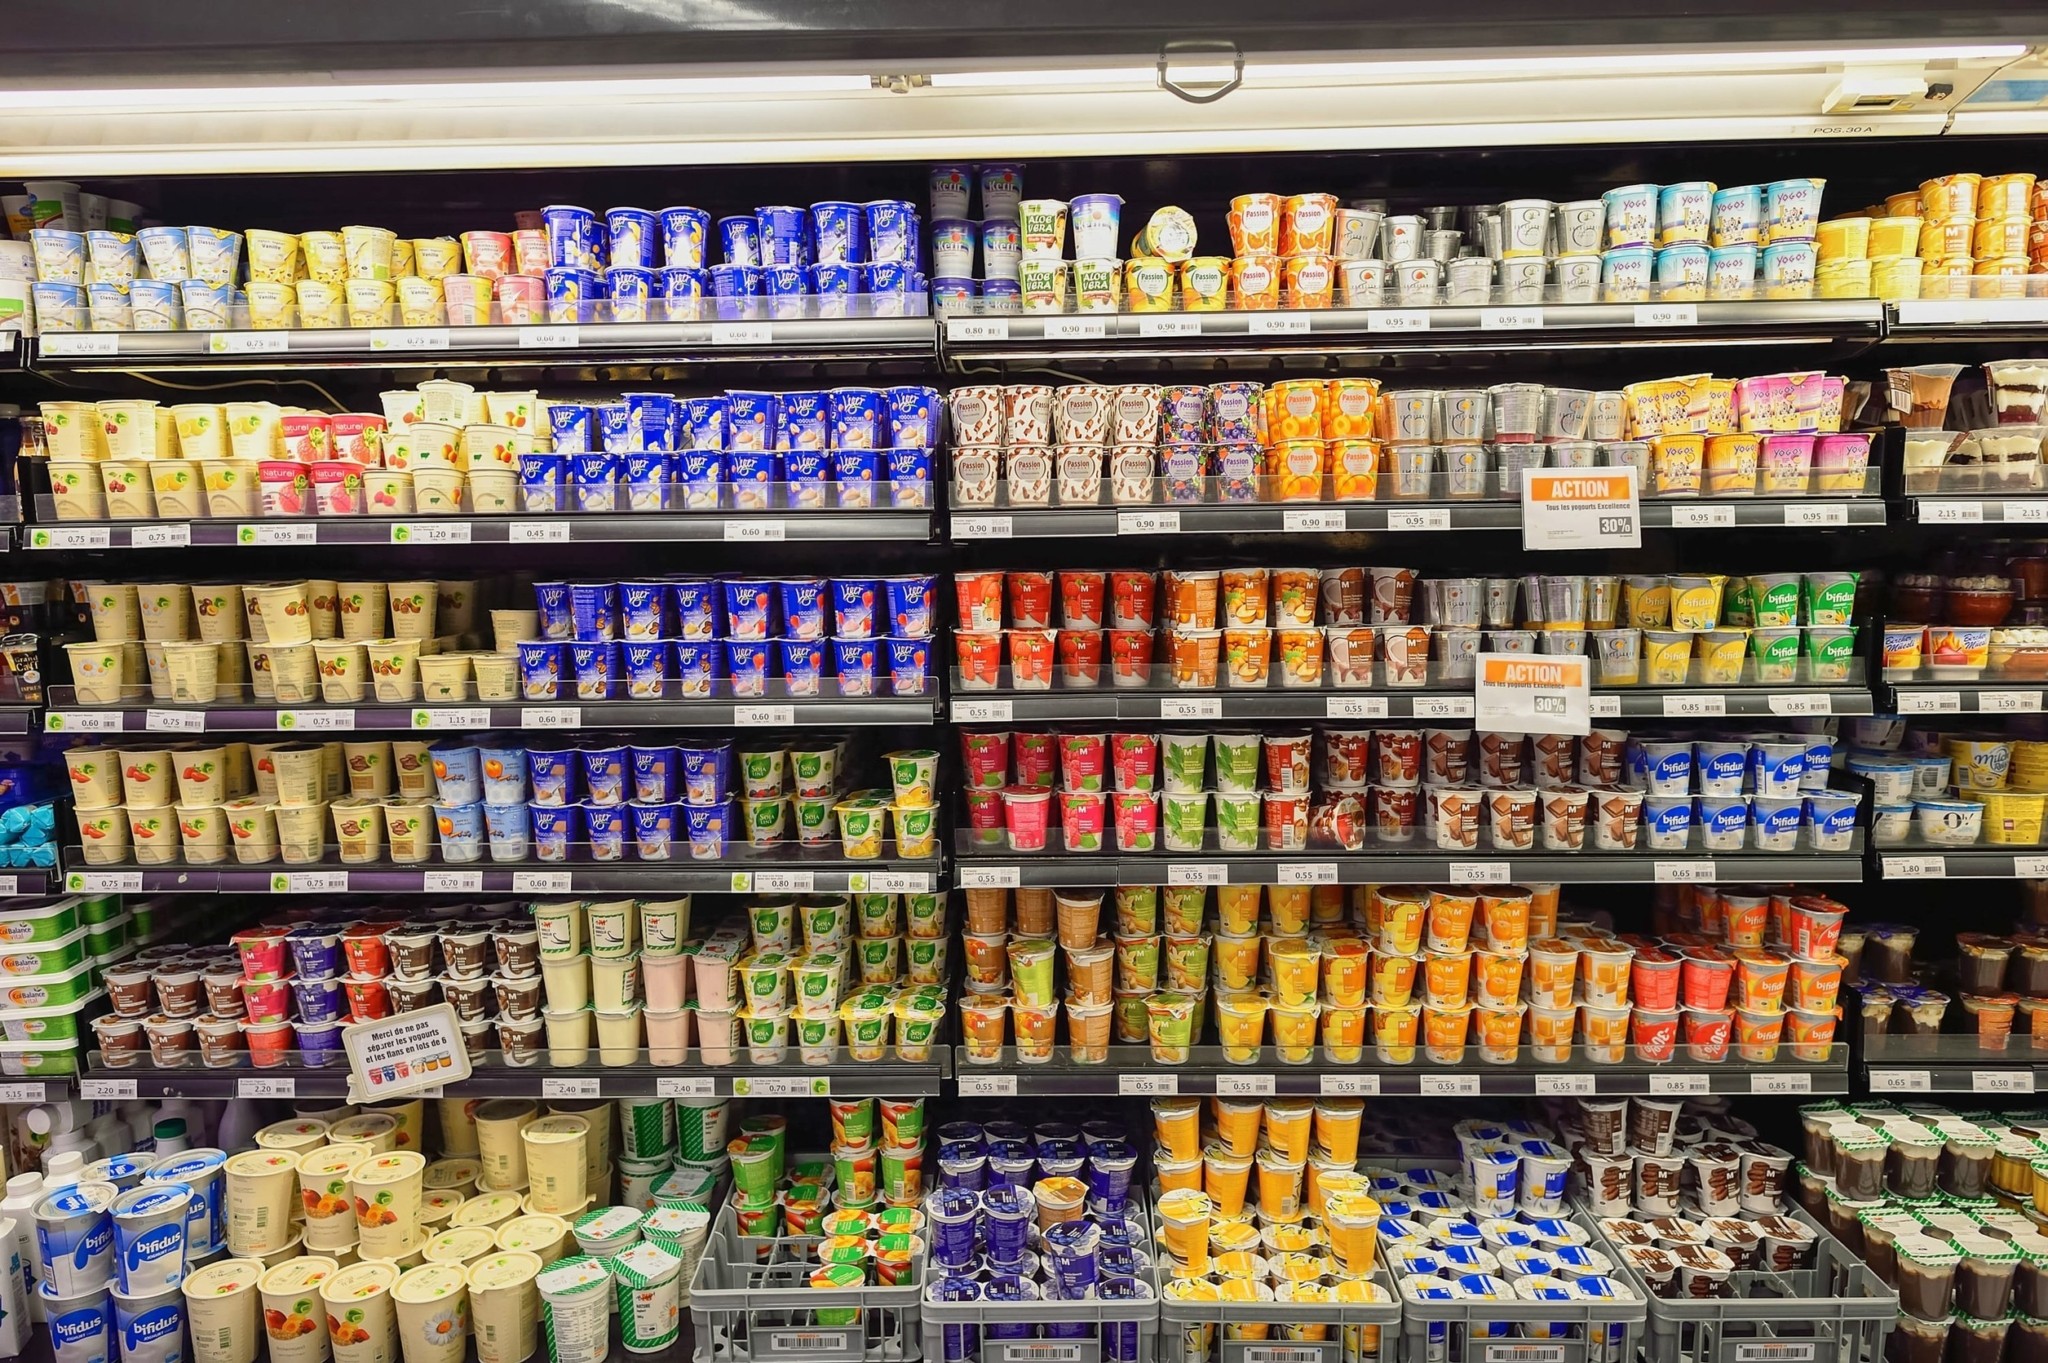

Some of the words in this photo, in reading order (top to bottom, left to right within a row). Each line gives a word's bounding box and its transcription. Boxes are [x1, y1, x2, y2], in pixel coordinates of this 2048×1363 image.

[1777, 189, 1808, 203] YOGOS
[1716, 200, 1745, 214] YOGOS
[1246, 210, 1268, 218] Passion
[1028, 215, 1052, 225] ALOE
[1028, 223, 1053, 234] VERA
[1777, 253, 1806, 267] YOGOS
[1026, 273, 1051, 282] ALOE
[1141, 273, 1164, 281] Passion
[1026, 281, 1051, 291] VERA
[965, 327, 983, 335] 0.80
[1221, 399, 1242, 407] Passion
[1289, 396, 1311, 404] Passion
[959, 402, 979, 410] Passion
[1666, 447, 1694, 456] YOGOS
[1774, 447, 1802, 457] YOGOS
[316, 470, 345, 478] Naturel
[1552, 480, 1609, 498] ACTION
[1571, 504, 1596, 512] yogourts
[1601, 518, 1631, 533] 30%
[148, 533, 165, 541] 0.75
[1506, 665, 1561, 682] ACTION
[1536, 697, 1565, 711] 30%
[1805, 754, 1831, 764] bifidus
[1663, 762, 1690, 772] bifidus
[1663, 815, 1689, 825] bifidus
[1718, 814, 1746, 825] bifidus
[1772, 815, 1799, 826] bifidus
[307, 879, 323, 887] 0.75
[372, 1029, 393, 1042] Merci
[395, 1027, 404, 1036] de
[405, 1024, 414, 1033] ne
[415, 1020, 429, 1031] pas
[396, 1035, 407, 1046] les
[408, 1028, 440, 1044] yogourts
[374, 1052, 385, 1063] les
[386, 1049, 404, 1061] flans
[406, 1048, 415, 1056] en
[416, 1041, 430, 1052] lots
[431, 1038, 440, 1048] de
[442, 1036, 447, 1044] 6
[137, 1231, 181, 1255] bifidus
[134, 1313, 178, 1336] bifidus
